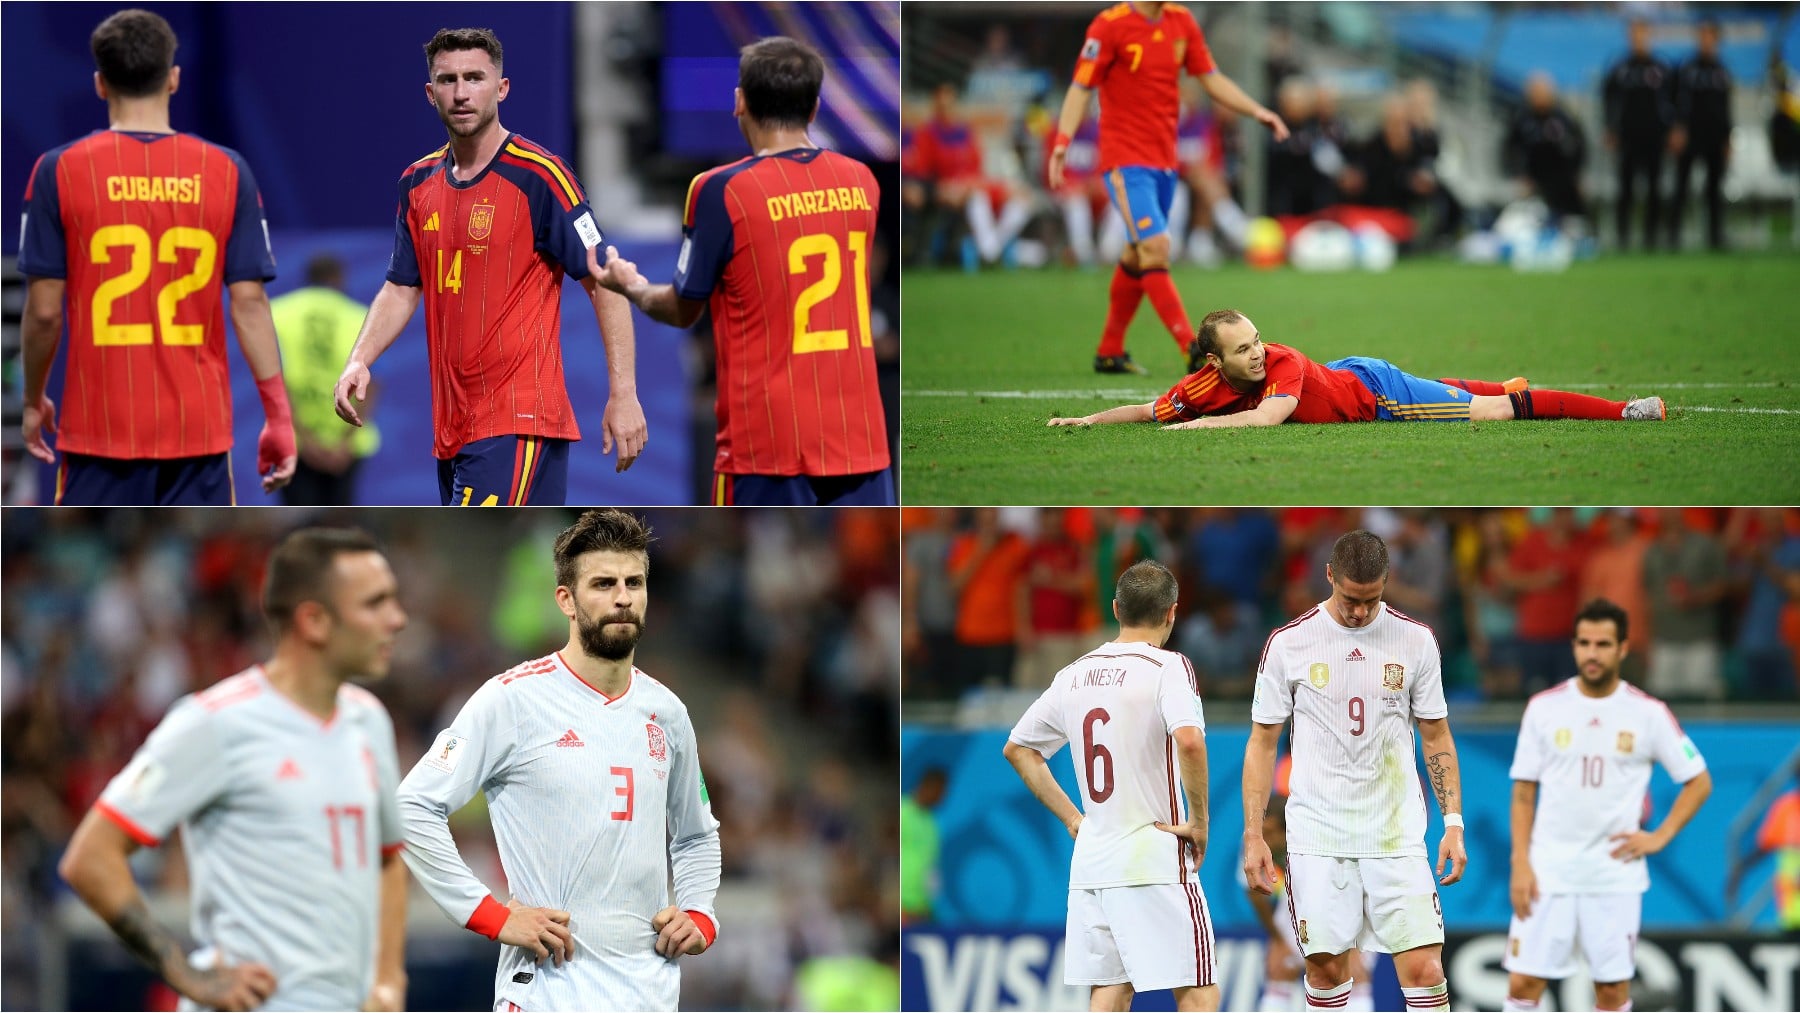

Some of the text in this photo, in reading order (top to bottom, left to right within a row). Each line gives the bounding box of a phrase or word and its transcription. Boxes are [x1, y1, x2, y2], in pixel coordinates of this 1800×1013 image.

[1126, 44, 1143, 72] 7
[107, 174, 201, 204] CUBARSÍ
[767, 187, 872, 222] OYARZABAL
[90, 224, 216, 346] 22
[437, 249, 462, 294] 14
[788, 231, 872, 354] 21
[1070, 668, 1127, 691] A. INIESTA
[1349, 697, 1365, 736] 9
[1083, 707, 1114, 804] 6
[1582, 756, 1604, 788] 10
[610, 766, 634, 822] 3
[324, 804, 367, 869] 17
